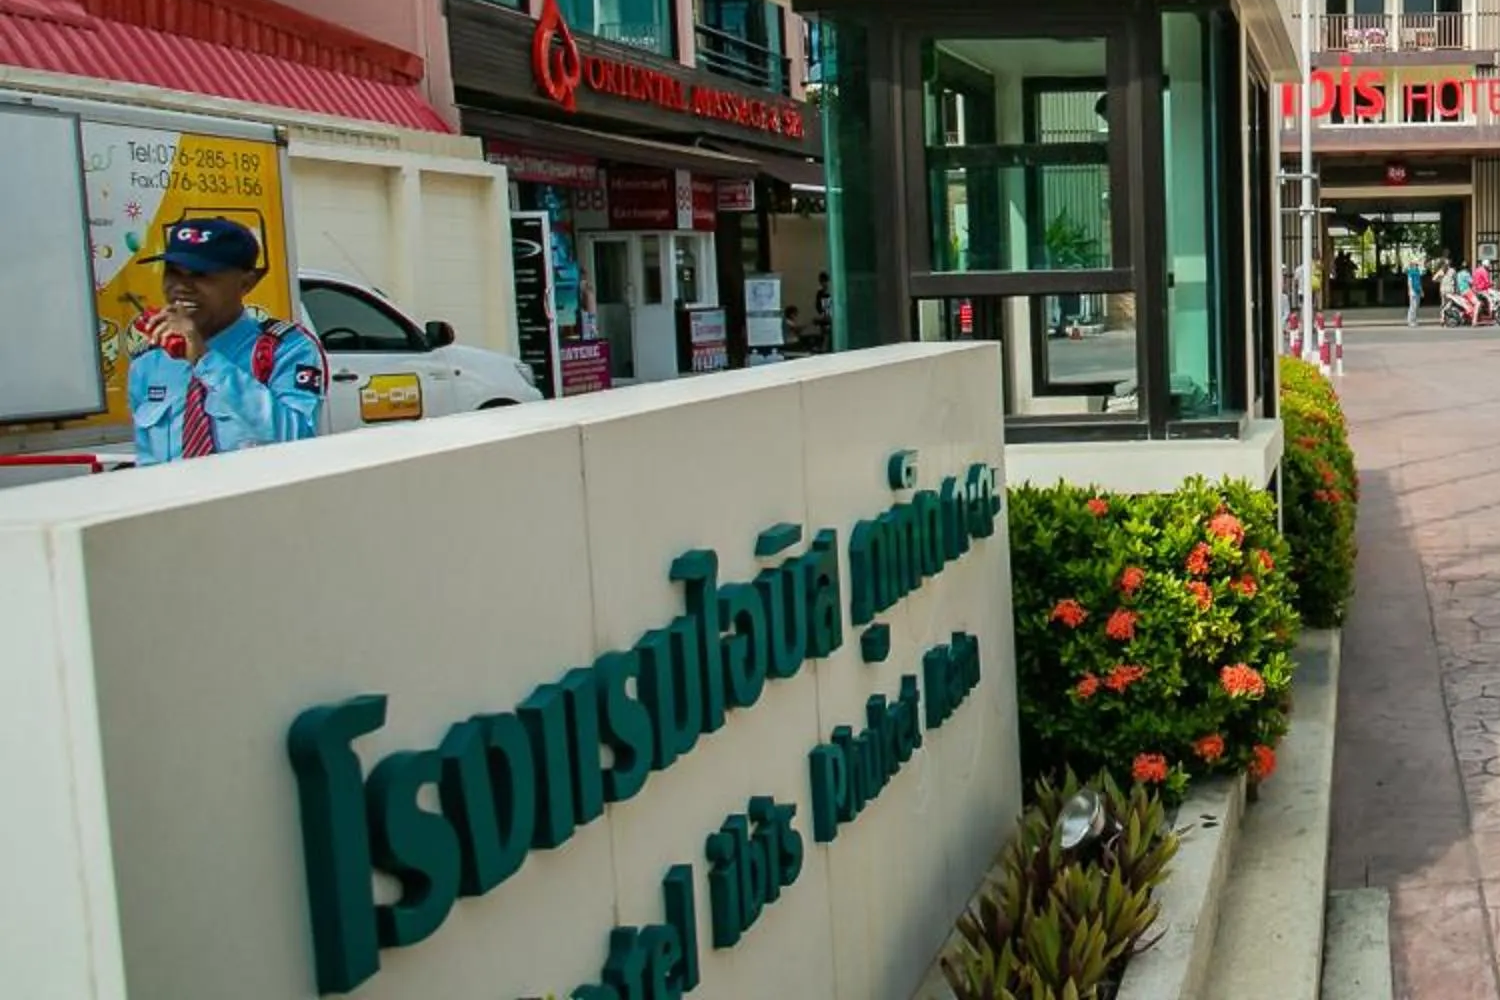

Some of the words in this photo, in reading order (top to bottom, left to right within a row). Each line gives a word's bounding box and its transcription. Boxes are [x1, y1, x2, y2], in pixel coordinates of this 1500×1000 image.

[584, 55, 689, 111] ORIENTAL
[688, 84, 769, 131] MASSAGE
[705, 795, 804, 949] ibis
